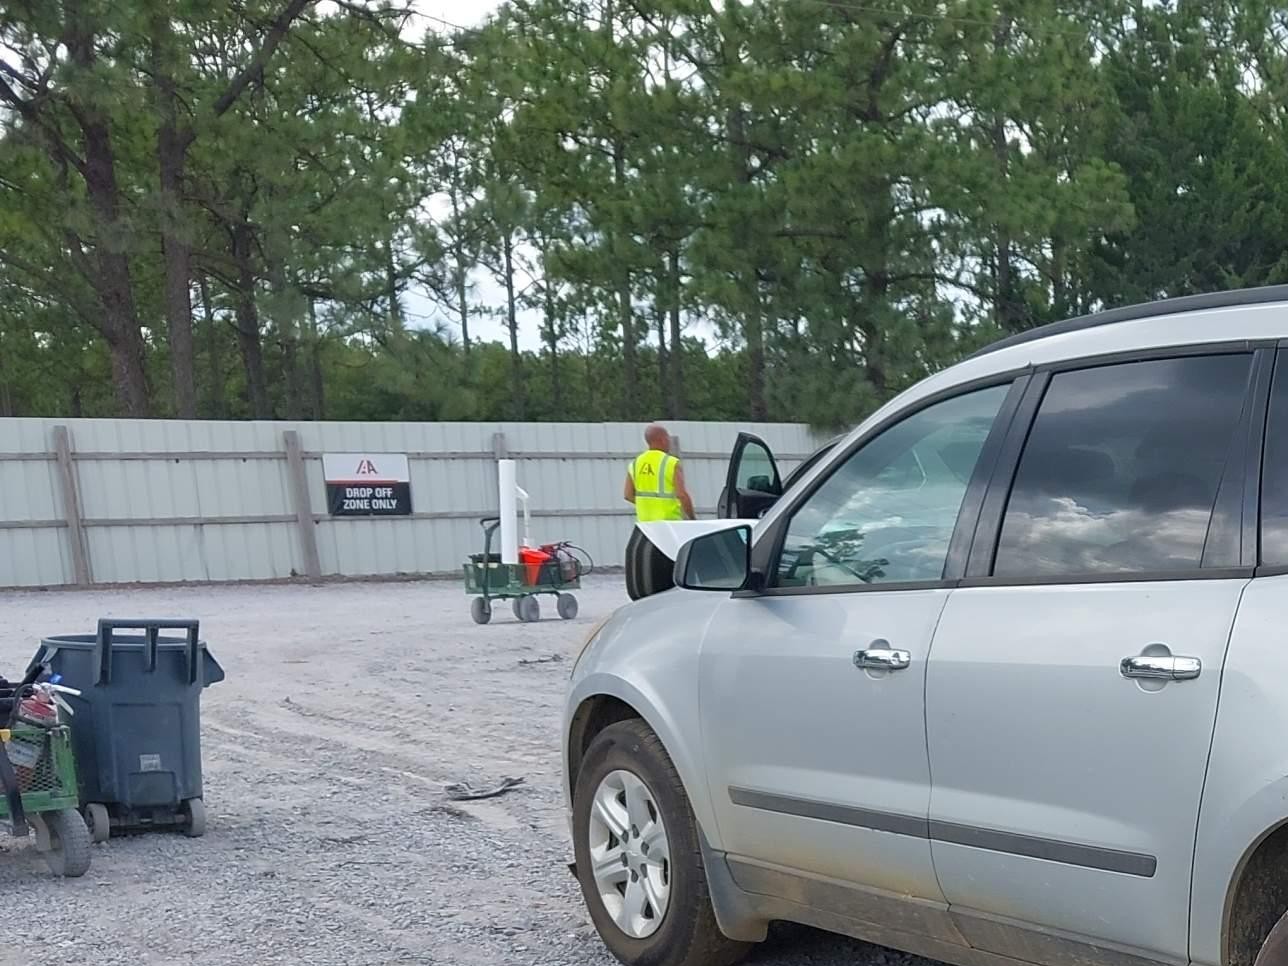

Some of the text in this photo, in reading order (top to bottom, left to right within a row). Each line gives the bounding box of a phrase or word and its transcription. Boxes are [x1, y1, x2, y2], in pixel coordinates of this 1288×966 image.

[345, 487, 393, 498] DROP OFF
[343, 499, 397, 510] ZONE ONLY
